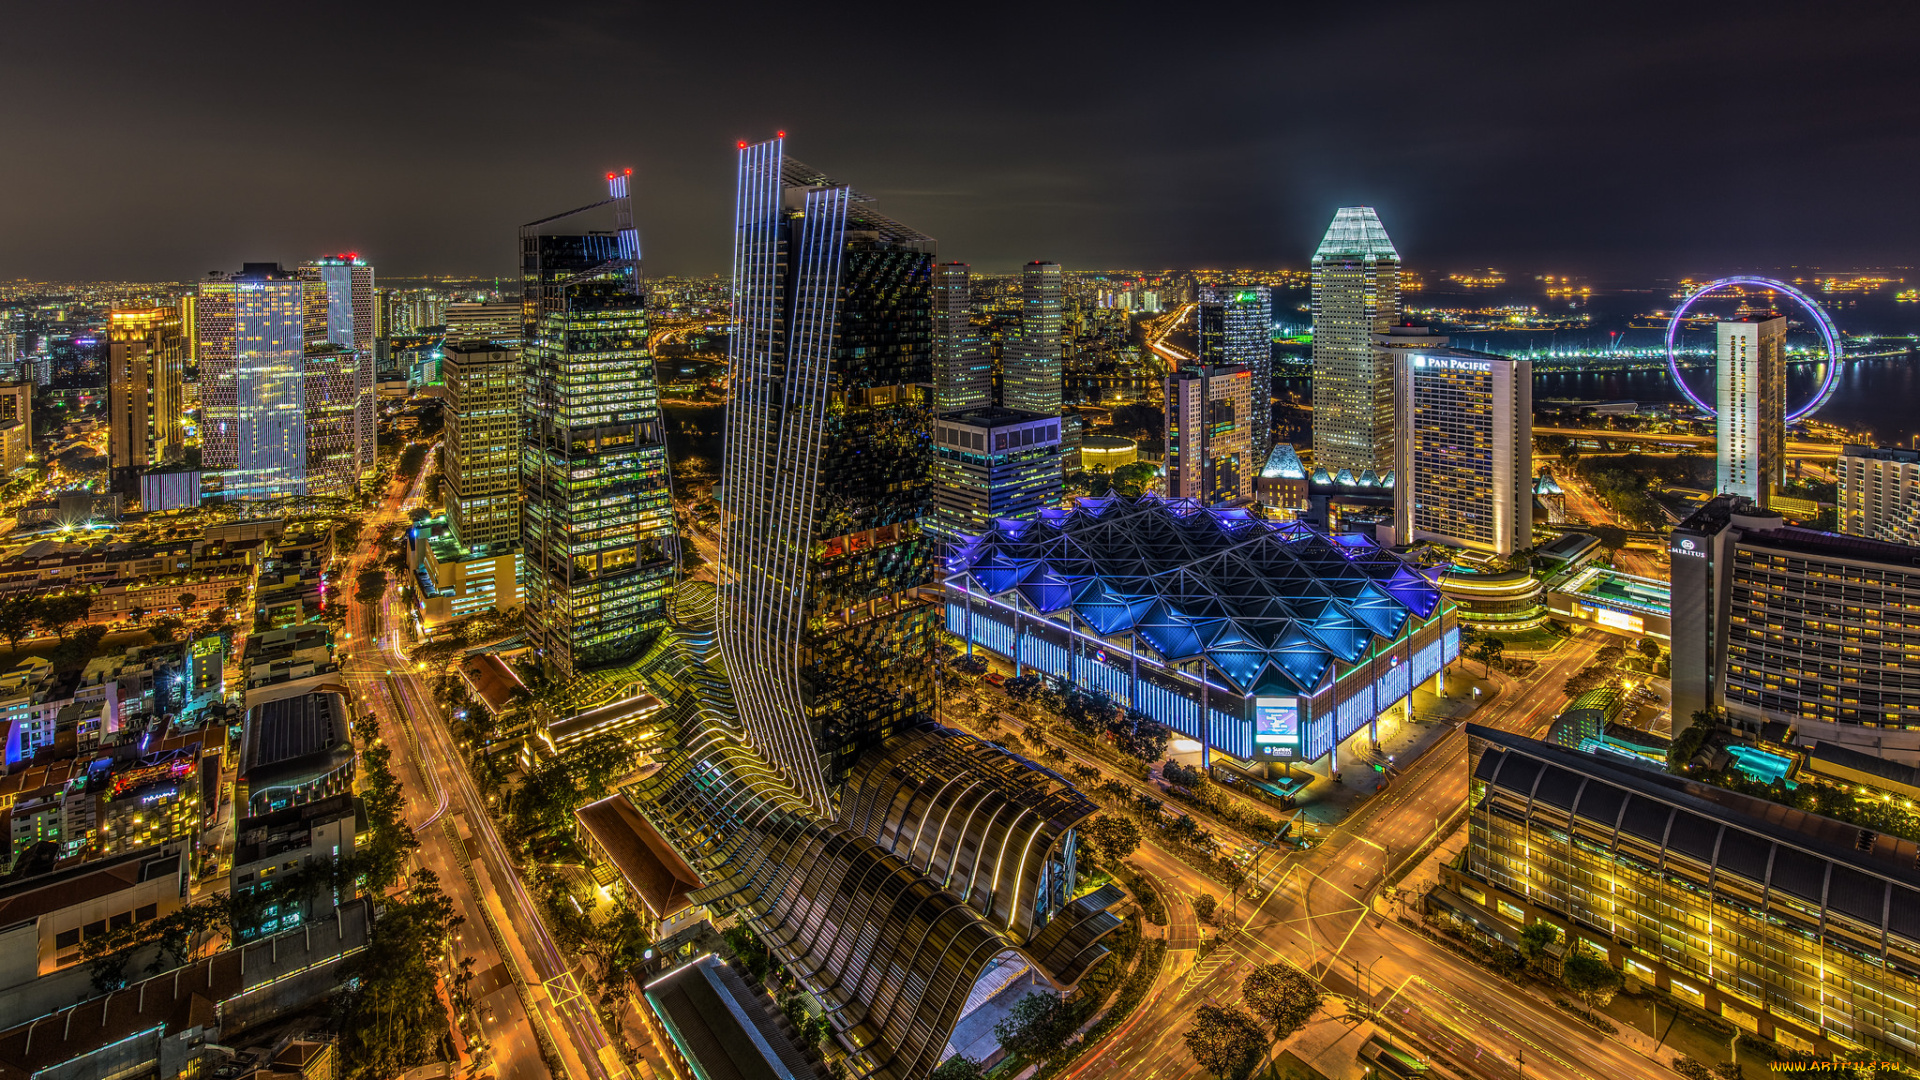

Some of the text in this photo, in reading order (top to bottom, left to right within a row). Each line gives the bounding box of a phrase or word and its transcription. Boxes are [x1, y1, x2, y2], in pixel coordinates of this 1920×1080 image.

[1428, 358, 1490, 370] PAN PACIFIC
[1672, 547, 1705, 557] MERITUS
[1580, 599, 1607, 610] MARINA
